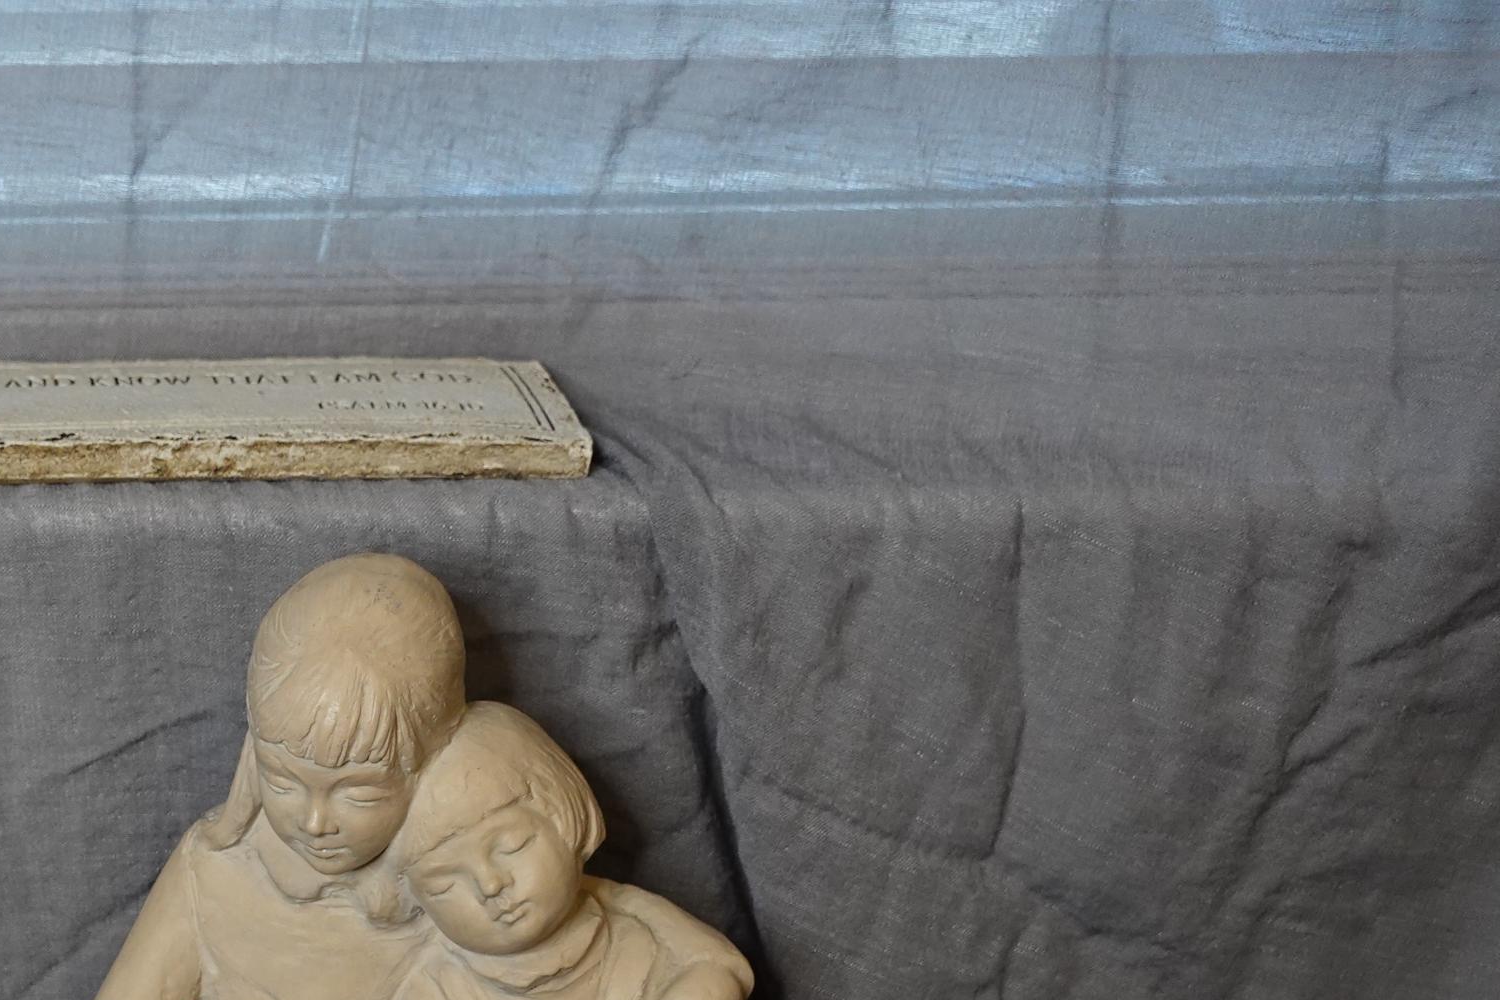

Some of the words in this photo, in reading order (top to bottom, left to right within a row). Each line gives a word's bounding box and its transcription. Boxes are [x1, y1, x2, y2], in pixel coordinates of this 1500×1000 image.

[4, 374, 77, 388] AND
[88, 374, 192, 387] KNOW
[333, 372, 382, 383] AM
